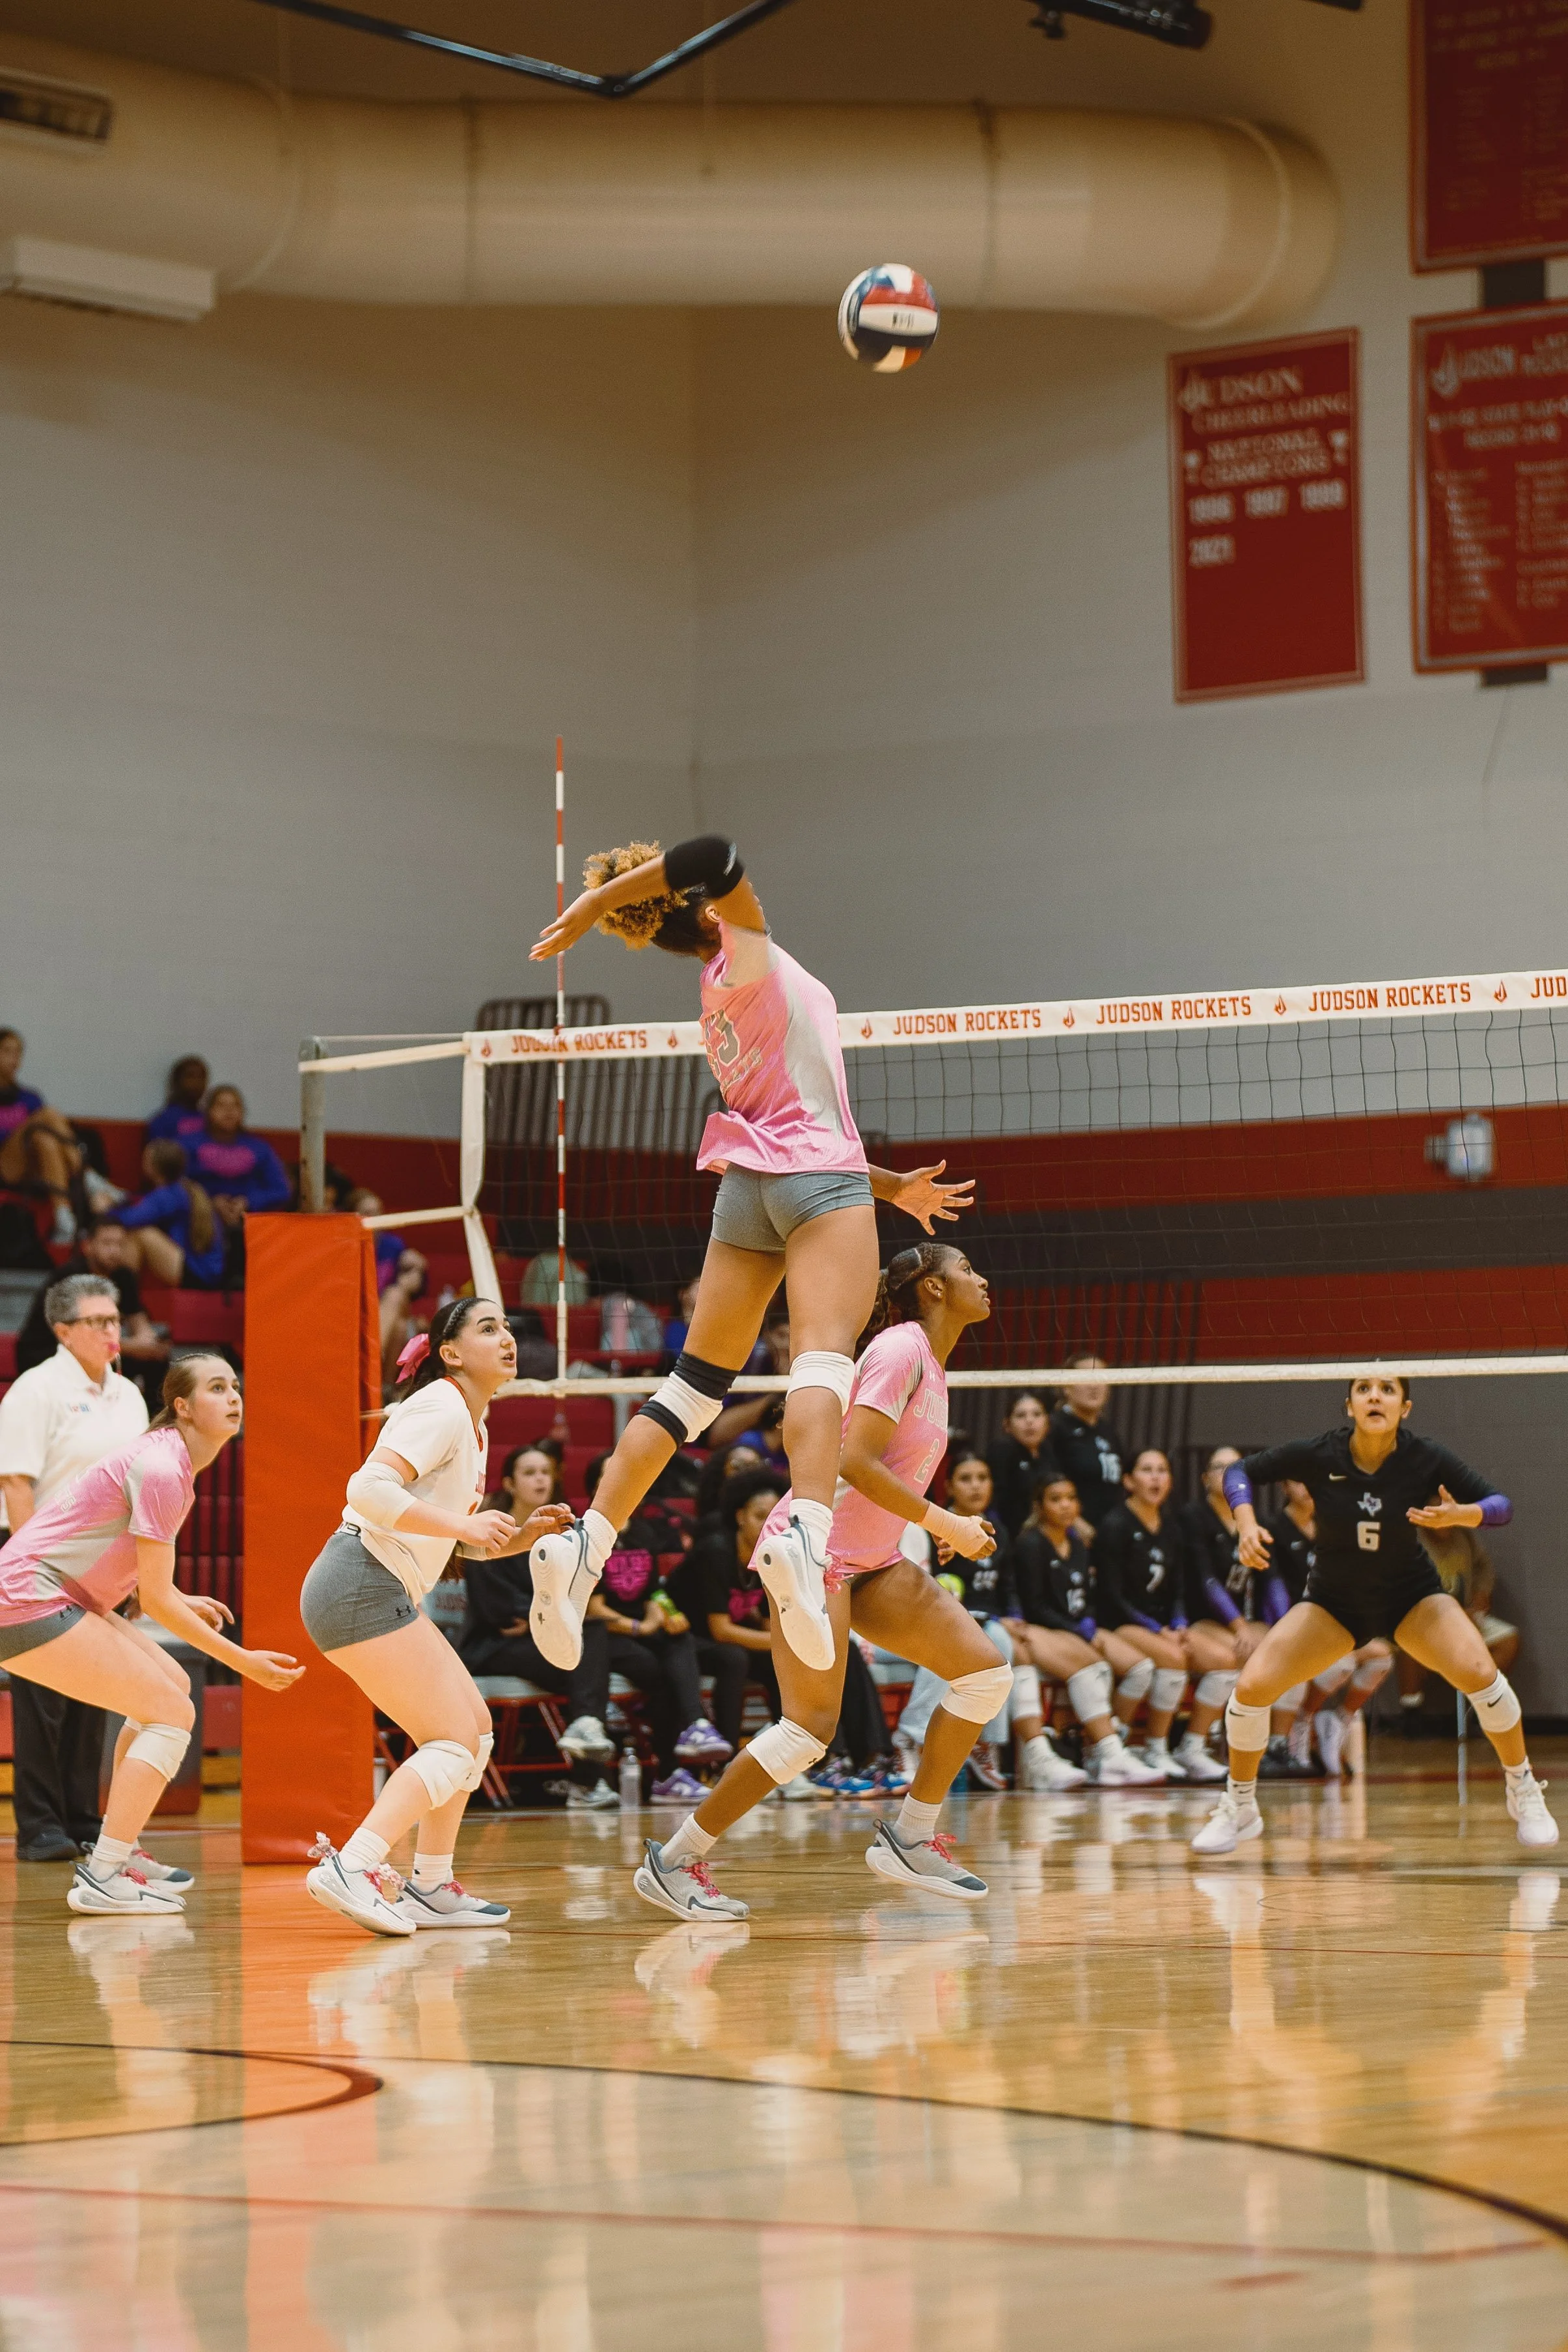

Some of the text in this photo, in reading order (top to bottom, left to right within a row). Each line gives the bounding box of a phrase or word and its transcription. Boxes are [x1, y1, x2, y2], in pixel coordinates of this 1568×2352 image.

[1096, 995, 1252, 1025] JUDSON ROCKETS
[1308, 982, 1471, 1012] JUDSON ROCKETS
[893, 1008, 1041, 1035] JUDSON ROCKETS
[574, 1029, 647, 1051] ROCKETS
[913, 1438, 939, 1484] 2
[1357, 1521, 1381, 1552] 6
[1146, 1564, 1165, 1593] 7
